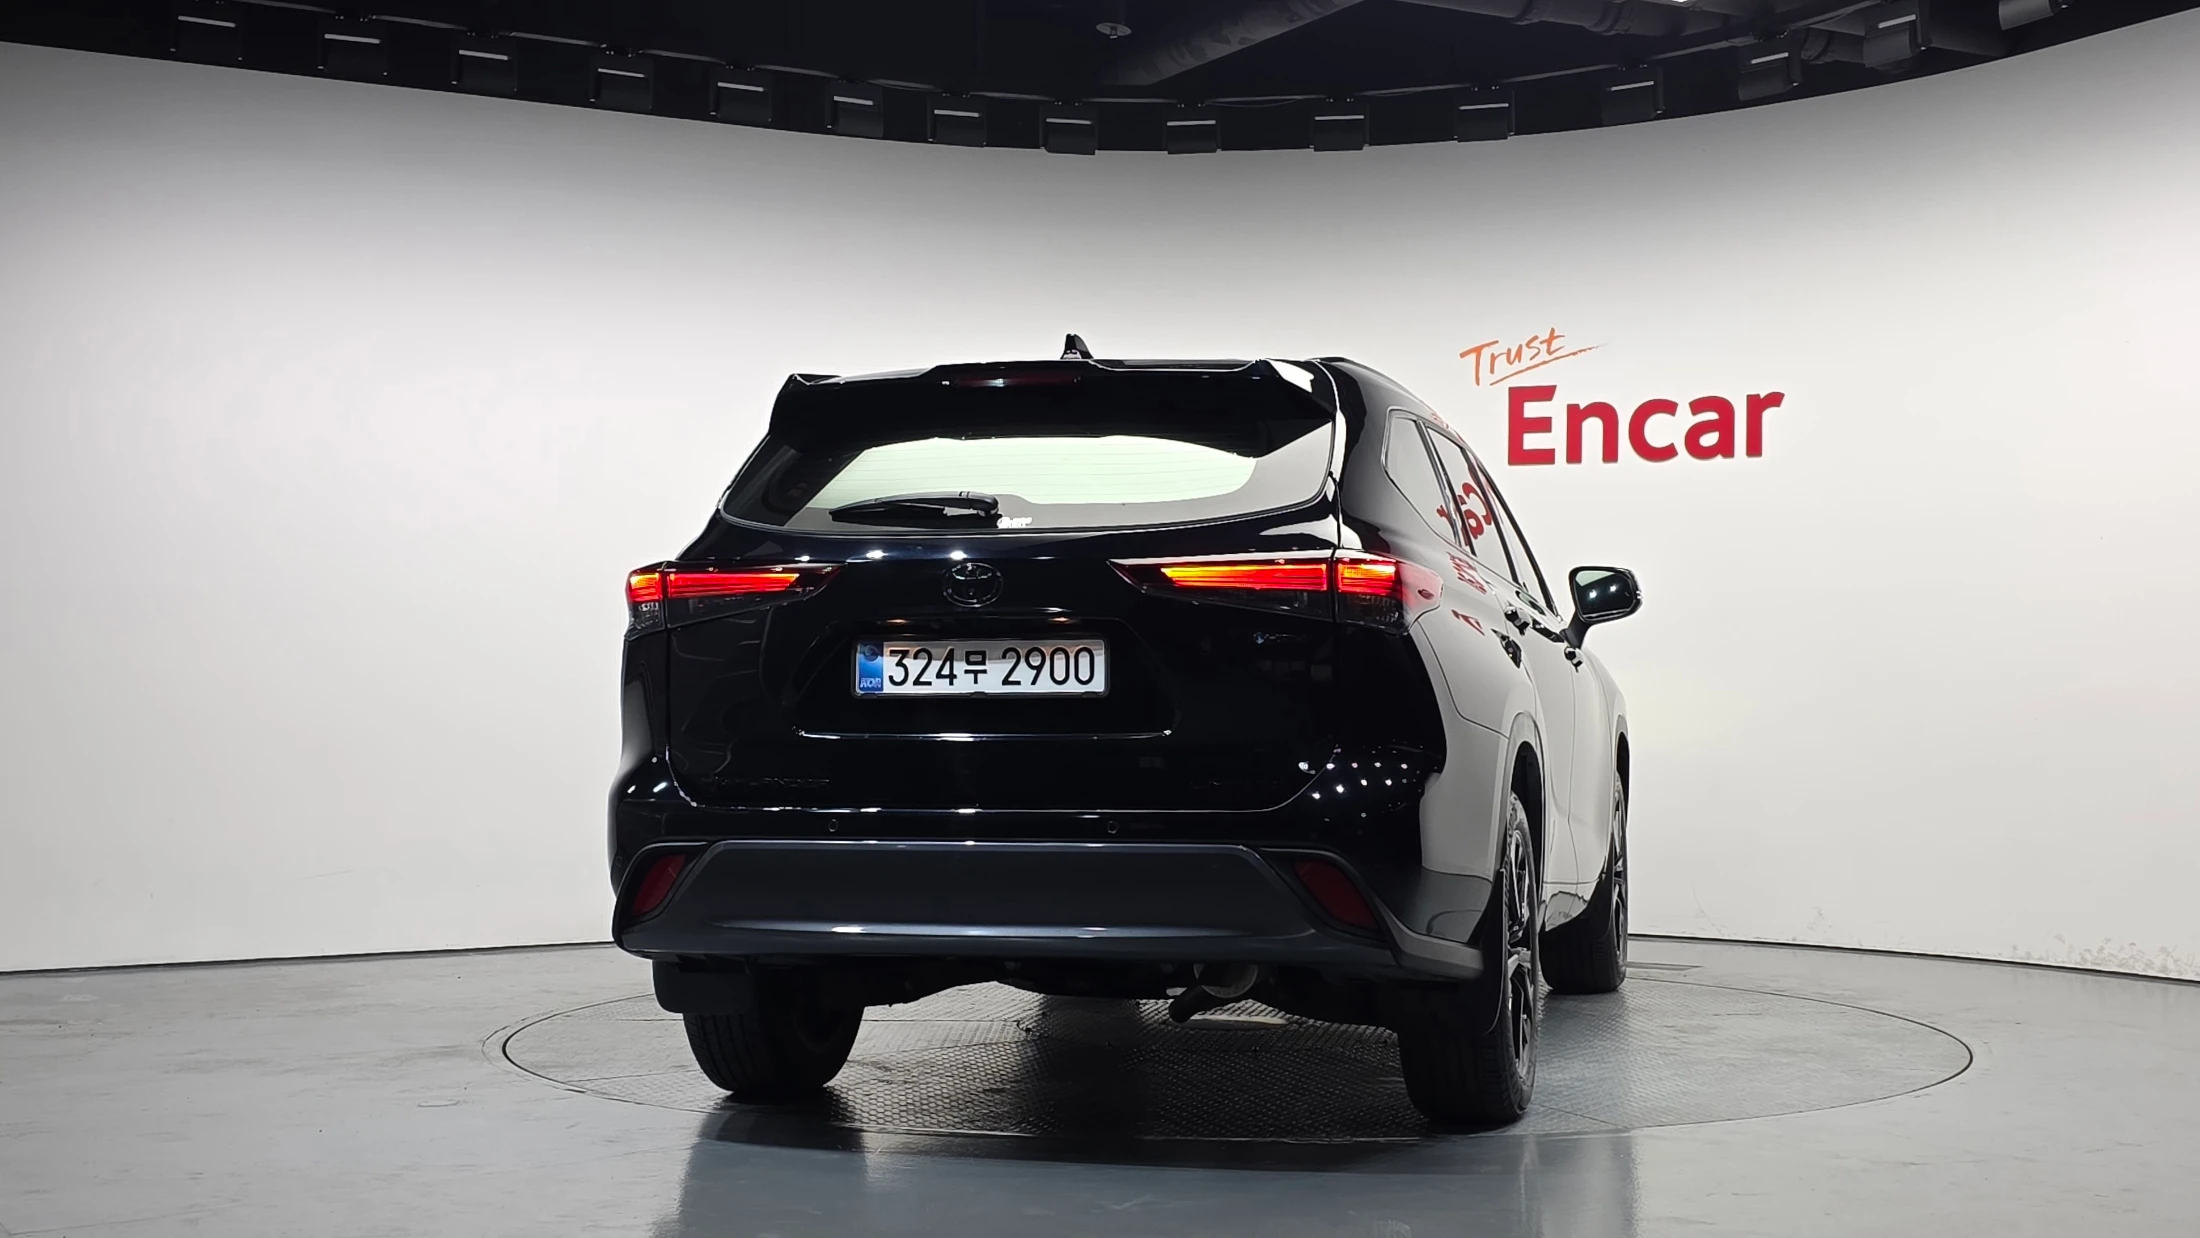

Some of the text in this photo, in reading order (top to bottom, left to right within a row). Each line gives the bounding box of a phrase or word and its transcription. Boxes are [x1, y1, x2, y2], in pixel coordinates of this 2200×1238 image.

[1459, 327, 1566, 386] Trust
[1508, 384, 1785, 466] Encar
[888, 646, 1095, 687] 324무 2900
